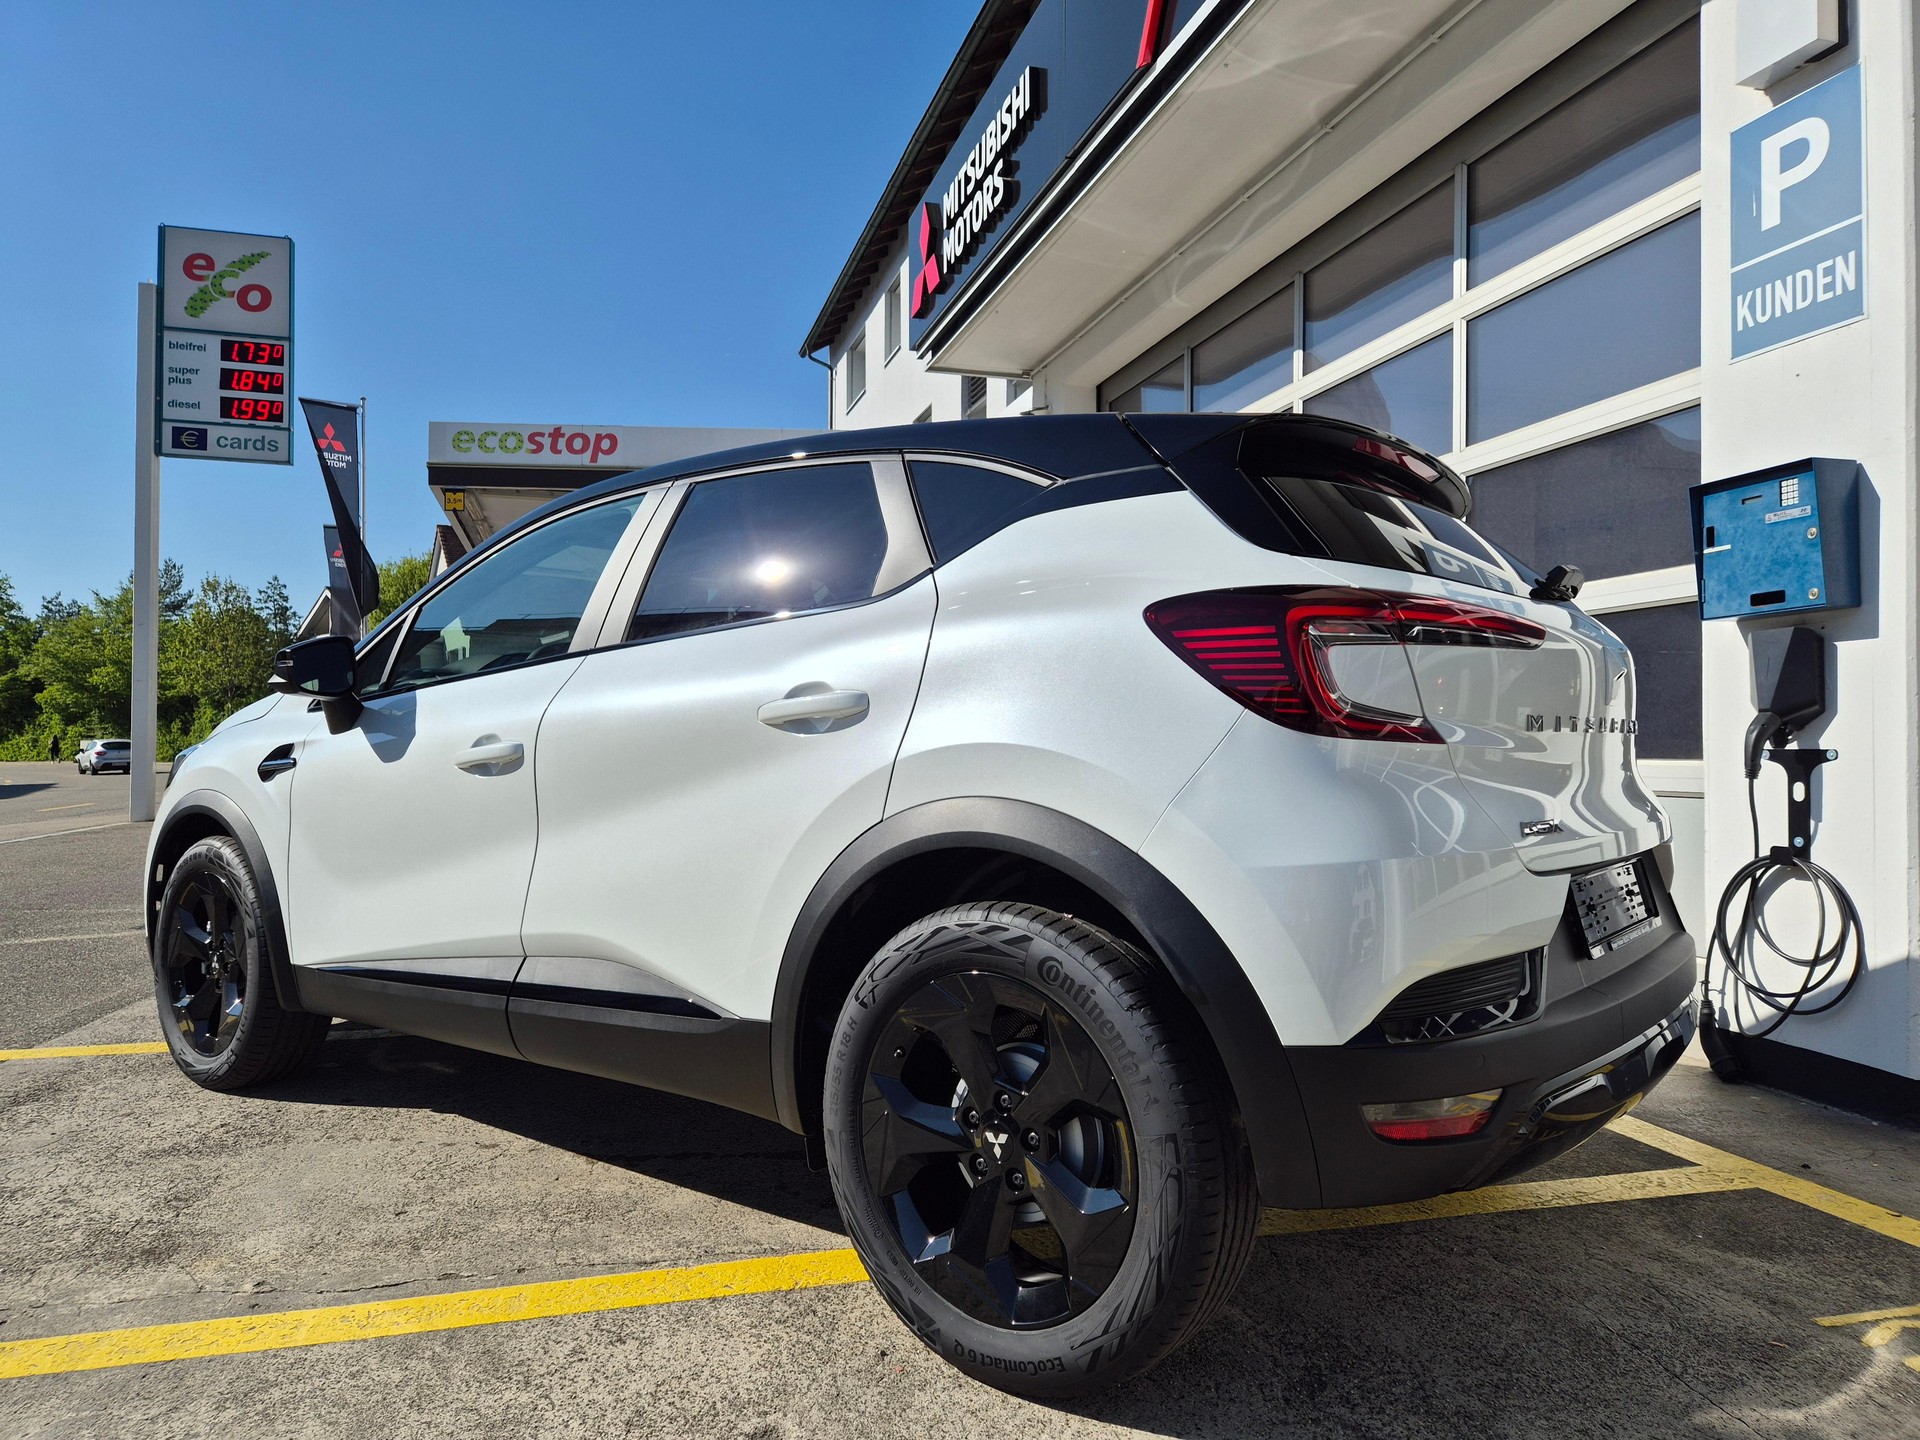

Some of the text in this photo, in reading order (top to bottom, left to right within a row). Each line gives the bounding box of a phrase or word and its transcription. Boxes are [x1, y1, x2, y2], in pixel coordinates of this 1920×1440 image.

[943, 66, 1030, 230] MITSUBISHI
[1761, 117, 1830, 232] P
[943, 158, 1004, 274] MOTORS
[183, 252, 273, 313] eco
[1736, 250, 1856, 332] KUNDEN
[168, 341, 207, 352] bleifrei
[168, 366, 200, 376] super
[168, 375, 192, 386] plus
[167, 399, 201, 410] diesel
[216, 435, 279, 452] cards
[452, 426, 618, 464] ecostop
[1036, 955, 1152, 1091] Continental
[953, 1338, 1066, 1377] EcoContact 6 Q
